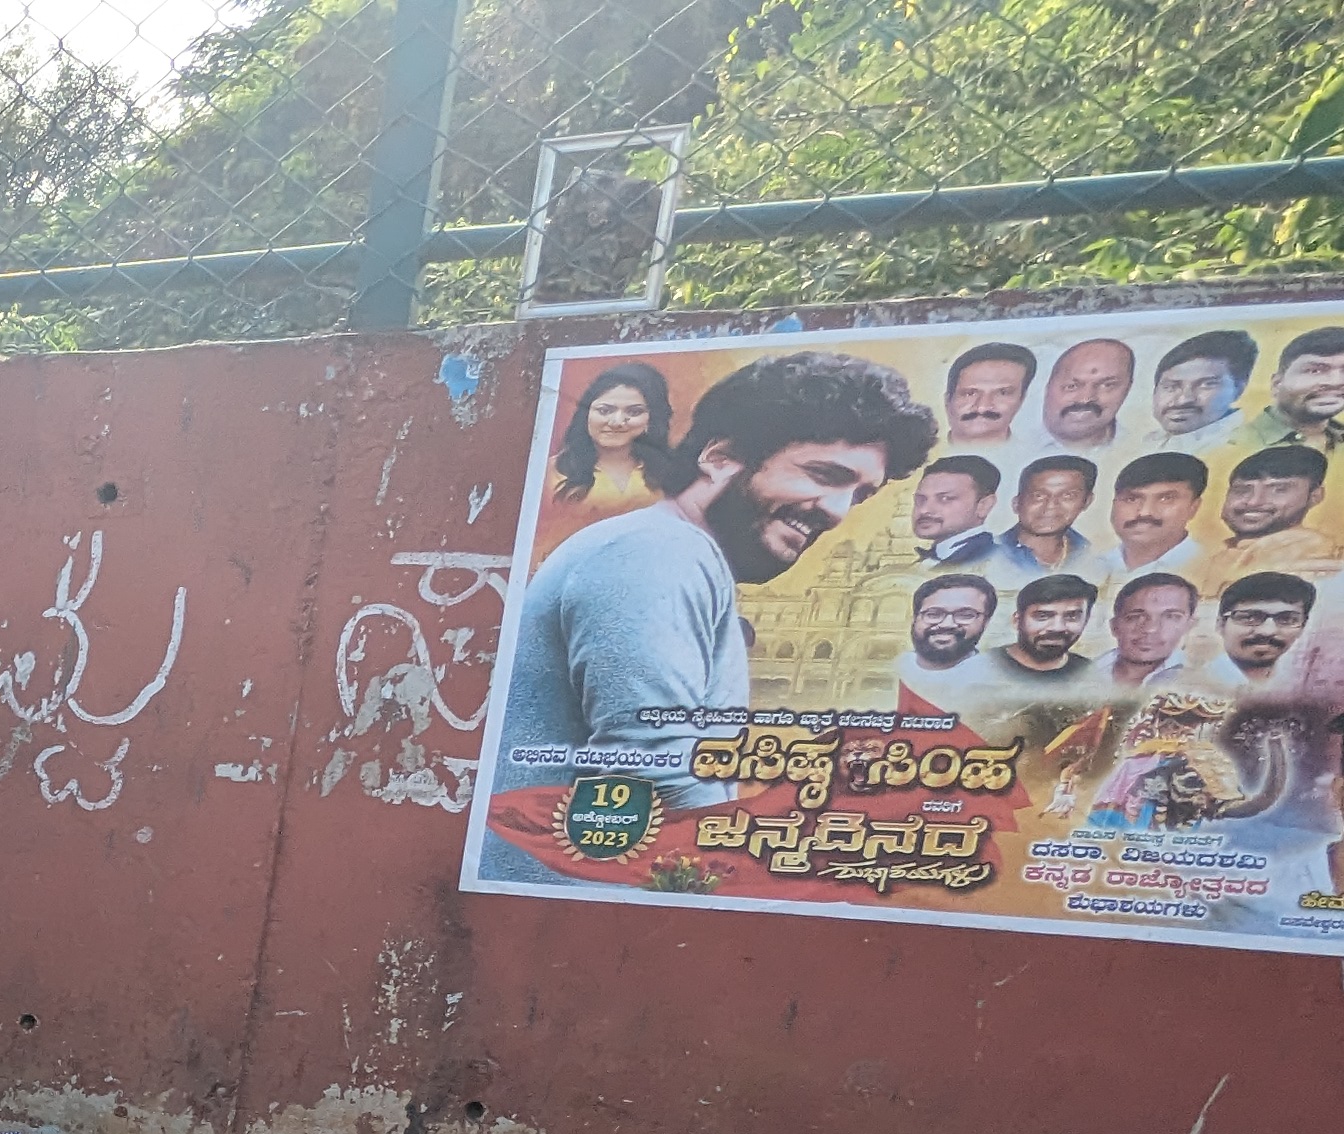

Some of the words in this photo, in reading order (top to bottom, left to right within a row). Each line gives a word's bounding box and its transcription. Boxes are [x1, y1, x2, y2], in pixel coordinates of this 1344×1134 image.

[753, 711, 794, 726] ಹಾಗೂ
[839, 714, 895, 732] ಚಲನಚಿತ್ರ
[900, 716, 955, 730] ನಟರಾದ
[512, 747, 567, 765] ಅಭಿನವ
[575, 748, 683, 768] ನಟಭಯಂಕರ
[691, 728, 842, 809] ವಸಿಷ್ಠ
[865, 737, 1023, 791] ಸಿಂಹ
[591, 784, 631, 809] 19
[580, 831, 628, 848] 2023
[697, 809, 988, 873] ಜನ್ಮದಿನದ
[1121, 846, 1267, 869] ವಿಜಯದಶಮಿ
[1024, 863, 1091, 889] ಕನ್ನಡ
[1106, 867, 1269, 900] ರಾಜ್ಯೋತ್ಸವದ
[1067, 893, 1207, 919] ಶುಭಾಶಯಗಳು
